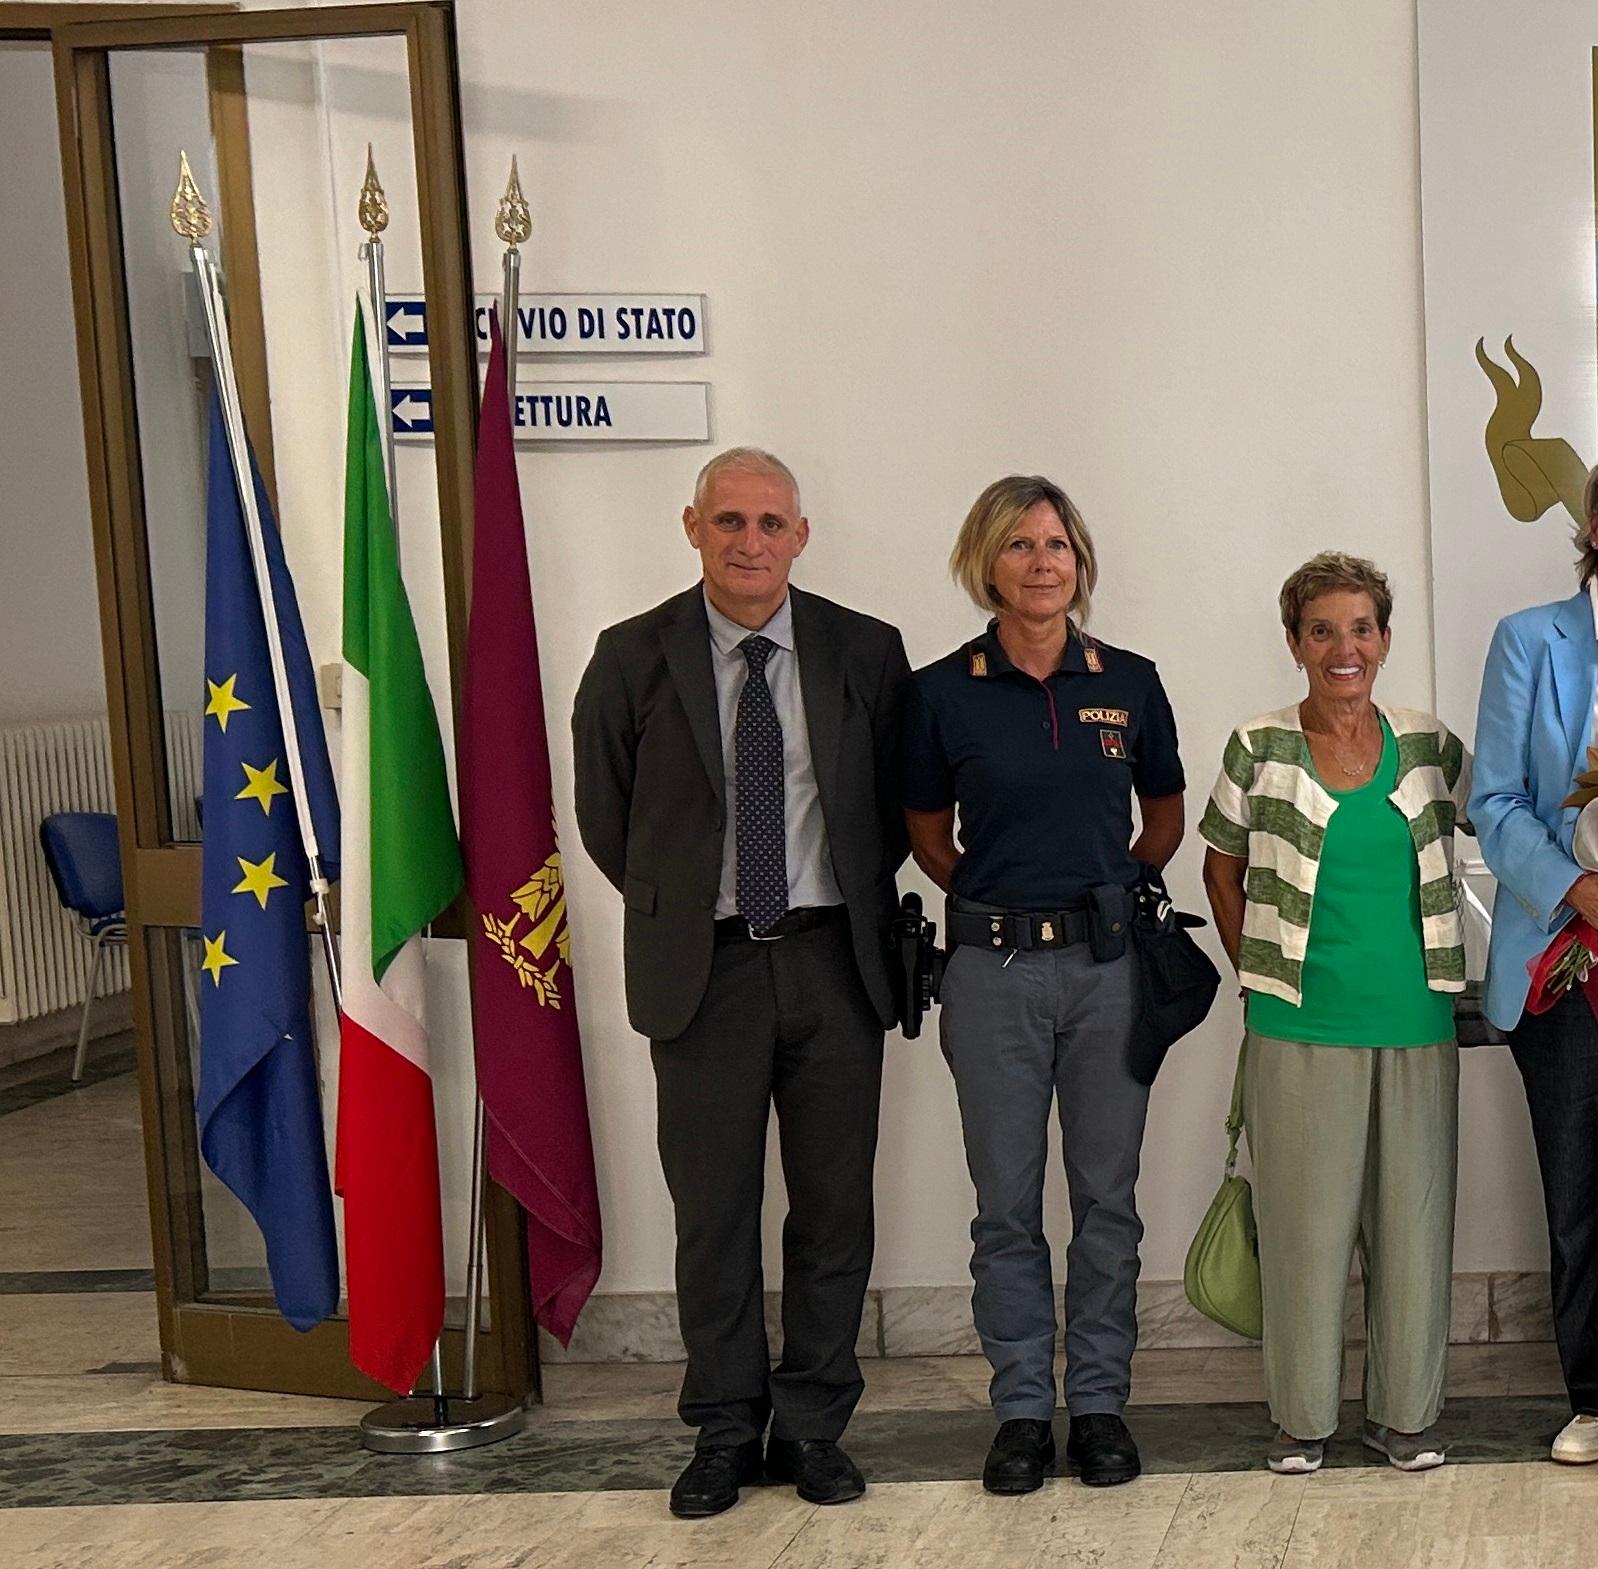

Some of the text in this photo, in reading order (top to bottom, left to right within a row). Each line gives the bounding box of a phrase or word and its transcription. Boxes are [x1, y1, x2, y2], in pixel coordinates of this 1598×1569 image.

[577, 307, 605, 340] DI
[615, 307, 696, 340] STATO
[514, 395, 612, 427] ETTURA
[1082, 711, 1127, 725] POLIZIA
